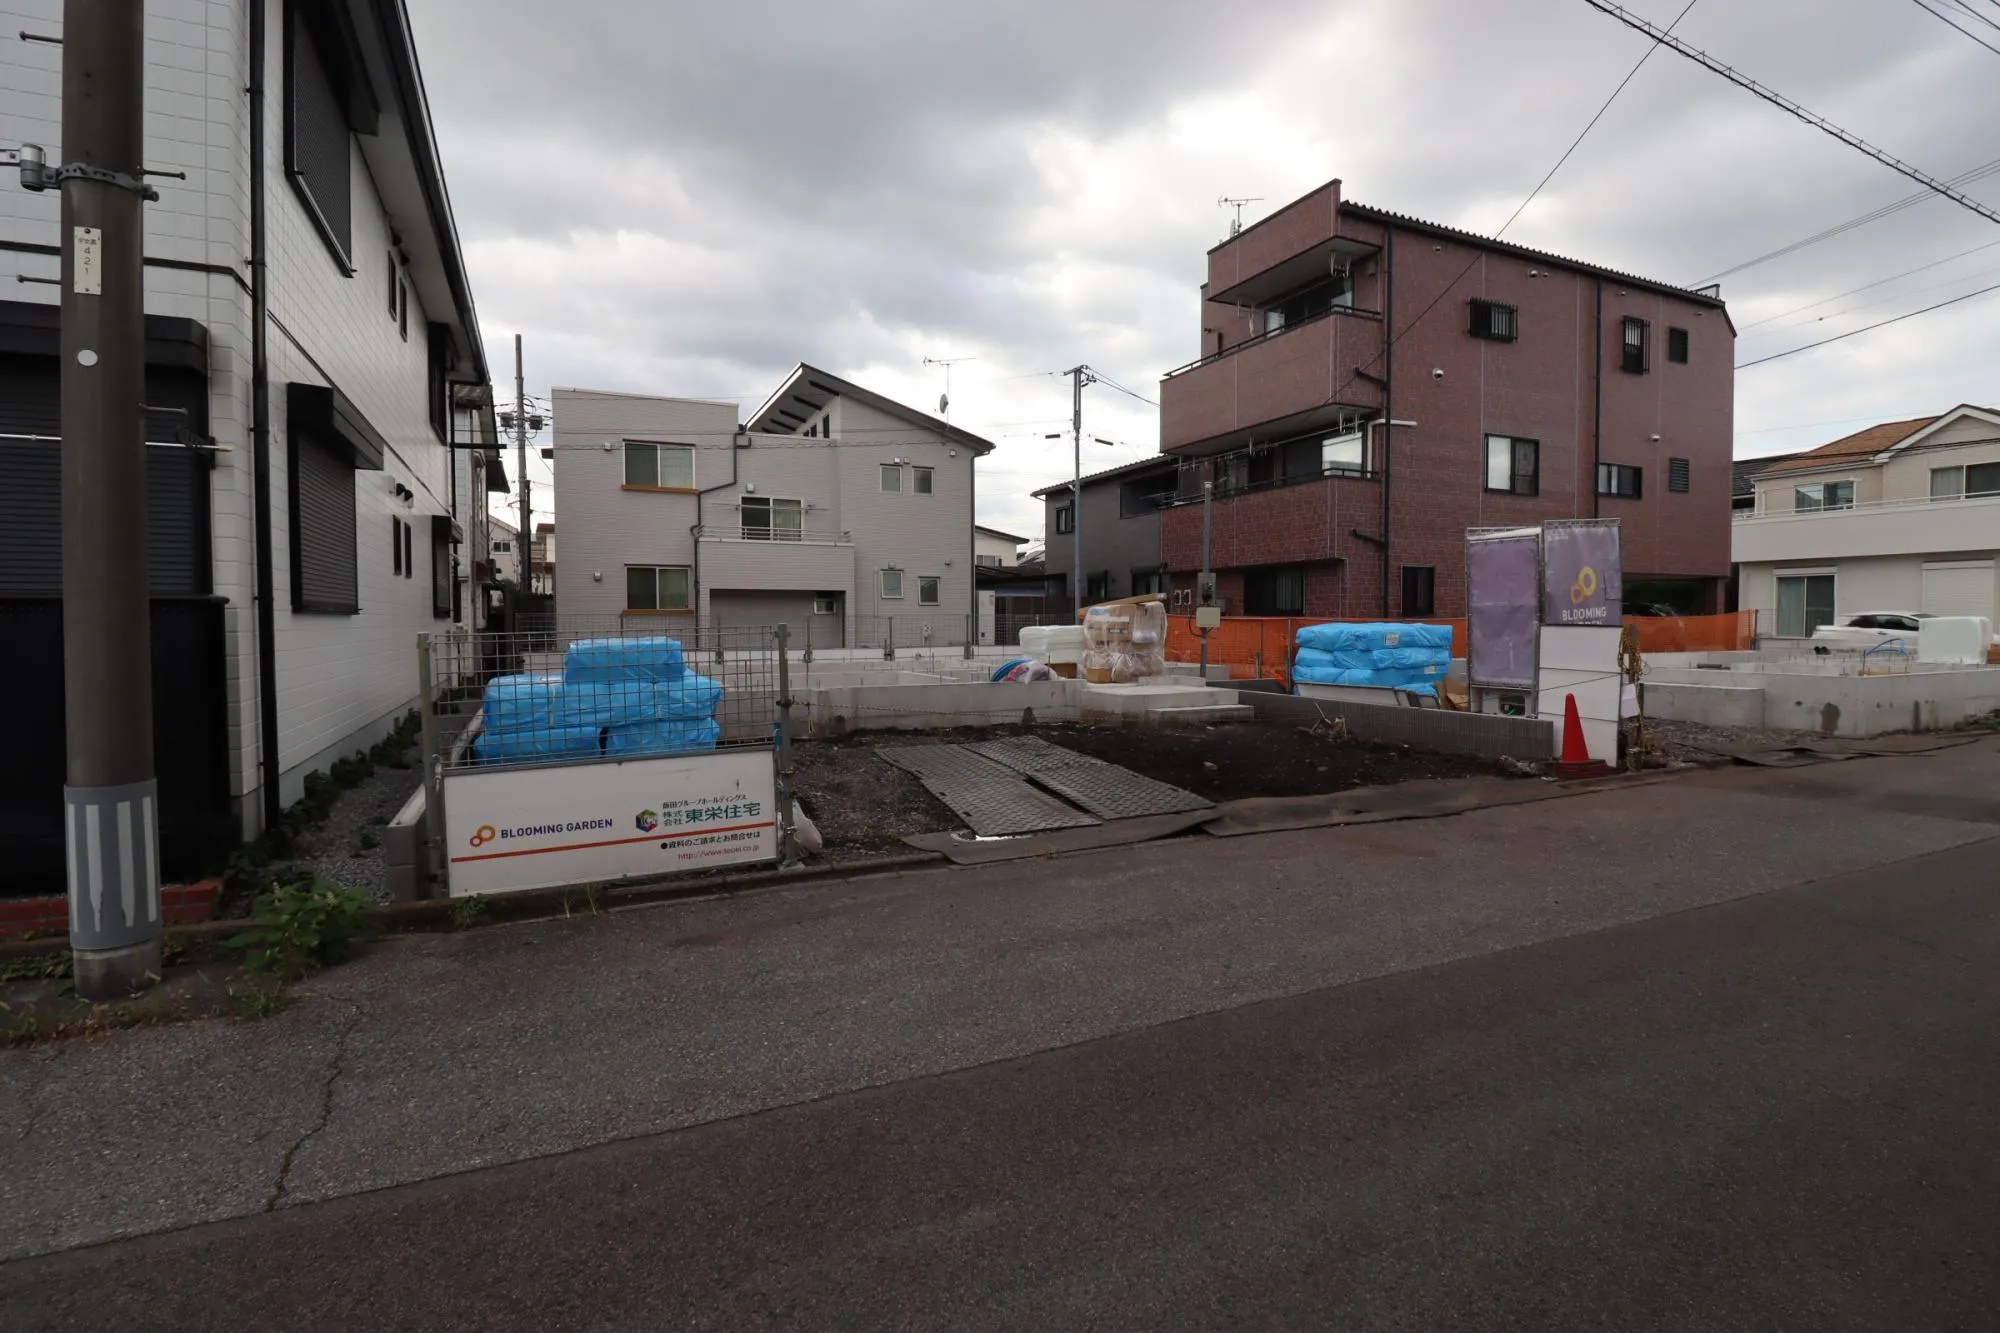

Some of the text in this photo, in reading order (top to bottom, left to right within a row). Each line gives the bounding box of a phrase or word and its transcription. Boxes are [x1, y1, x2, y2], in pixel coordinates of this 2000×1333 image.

[1562, 606, 1607, 621] BLOOMING
[685, 802, 761, 824] 東栄住宅
[501, 818, 613, 839] BLOOMING GARDEN
